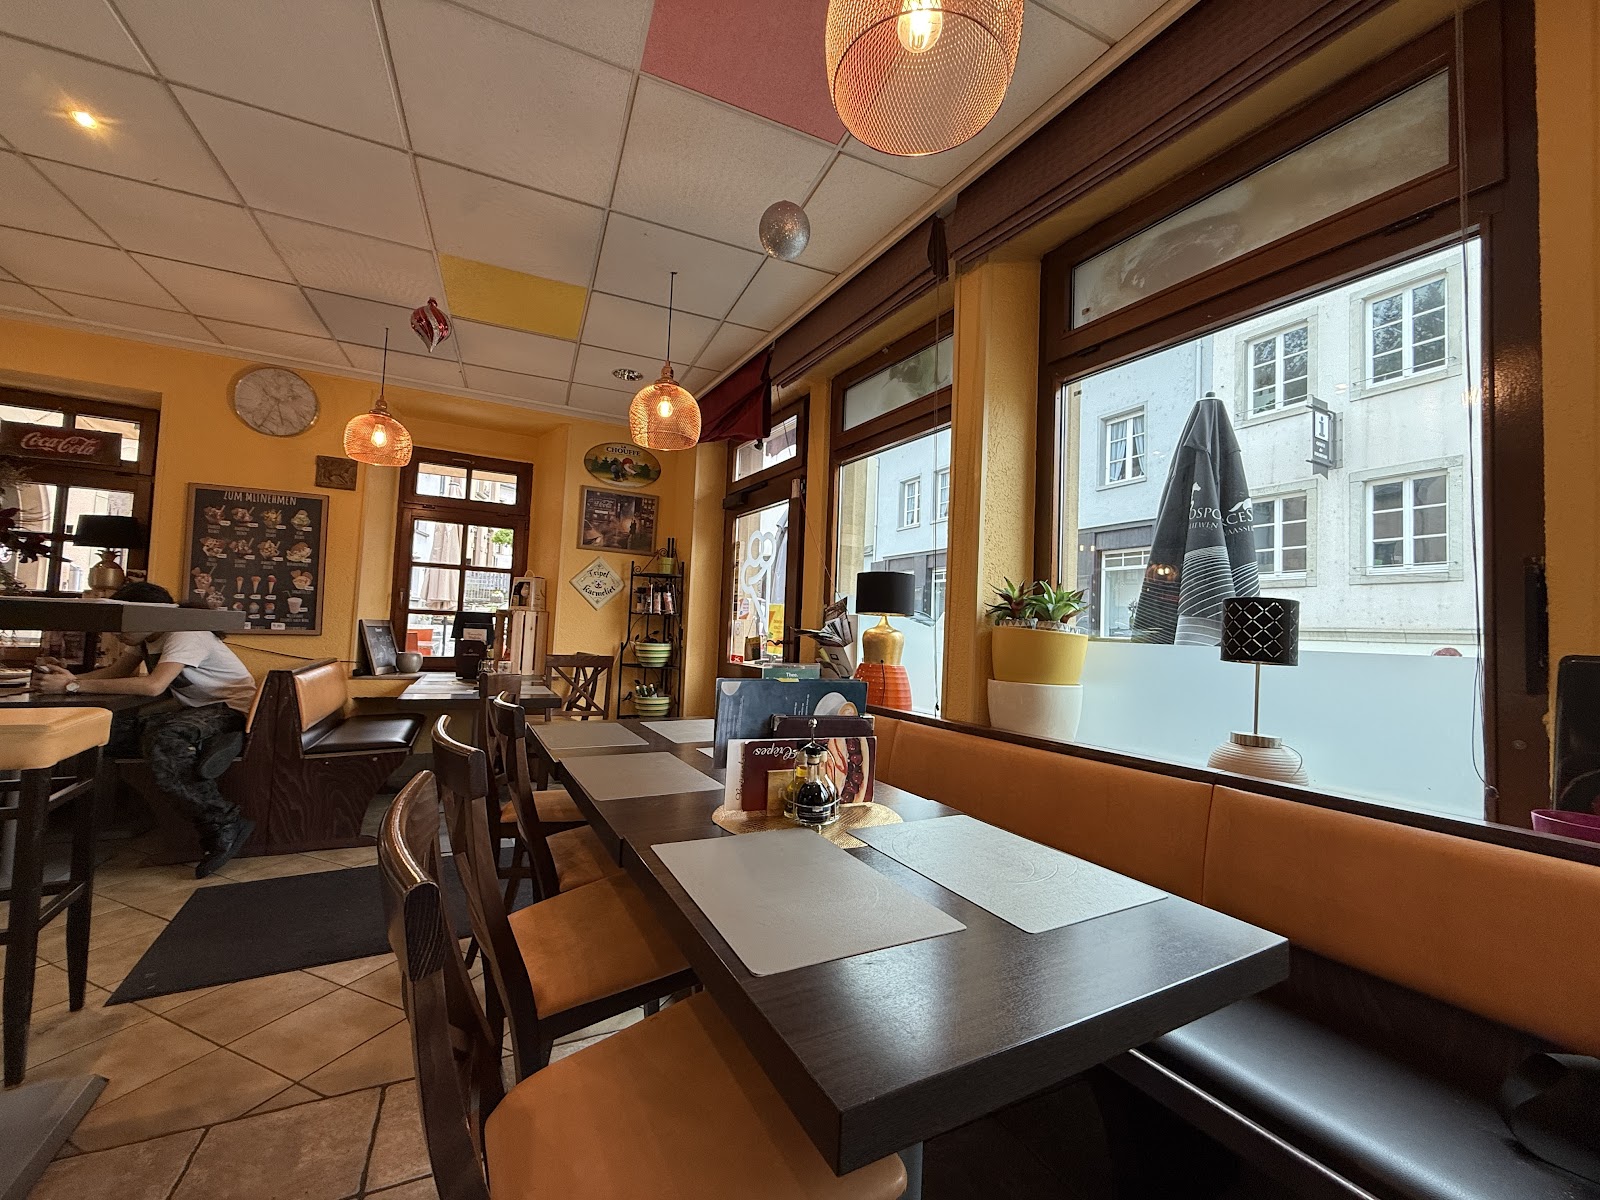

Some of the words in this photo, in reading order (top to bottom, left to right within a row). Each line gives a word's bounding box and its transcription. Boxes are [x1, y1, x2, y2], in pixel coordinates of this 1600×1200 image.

[606, 446, 641, 456] CHOUFFE
[223, 491, 243, 502] ZUM
[587, 569, 610, 578] Tripel
[582, 584, 616, 597] Karmeliet
[752, 742, 797, 761] Crêpes
